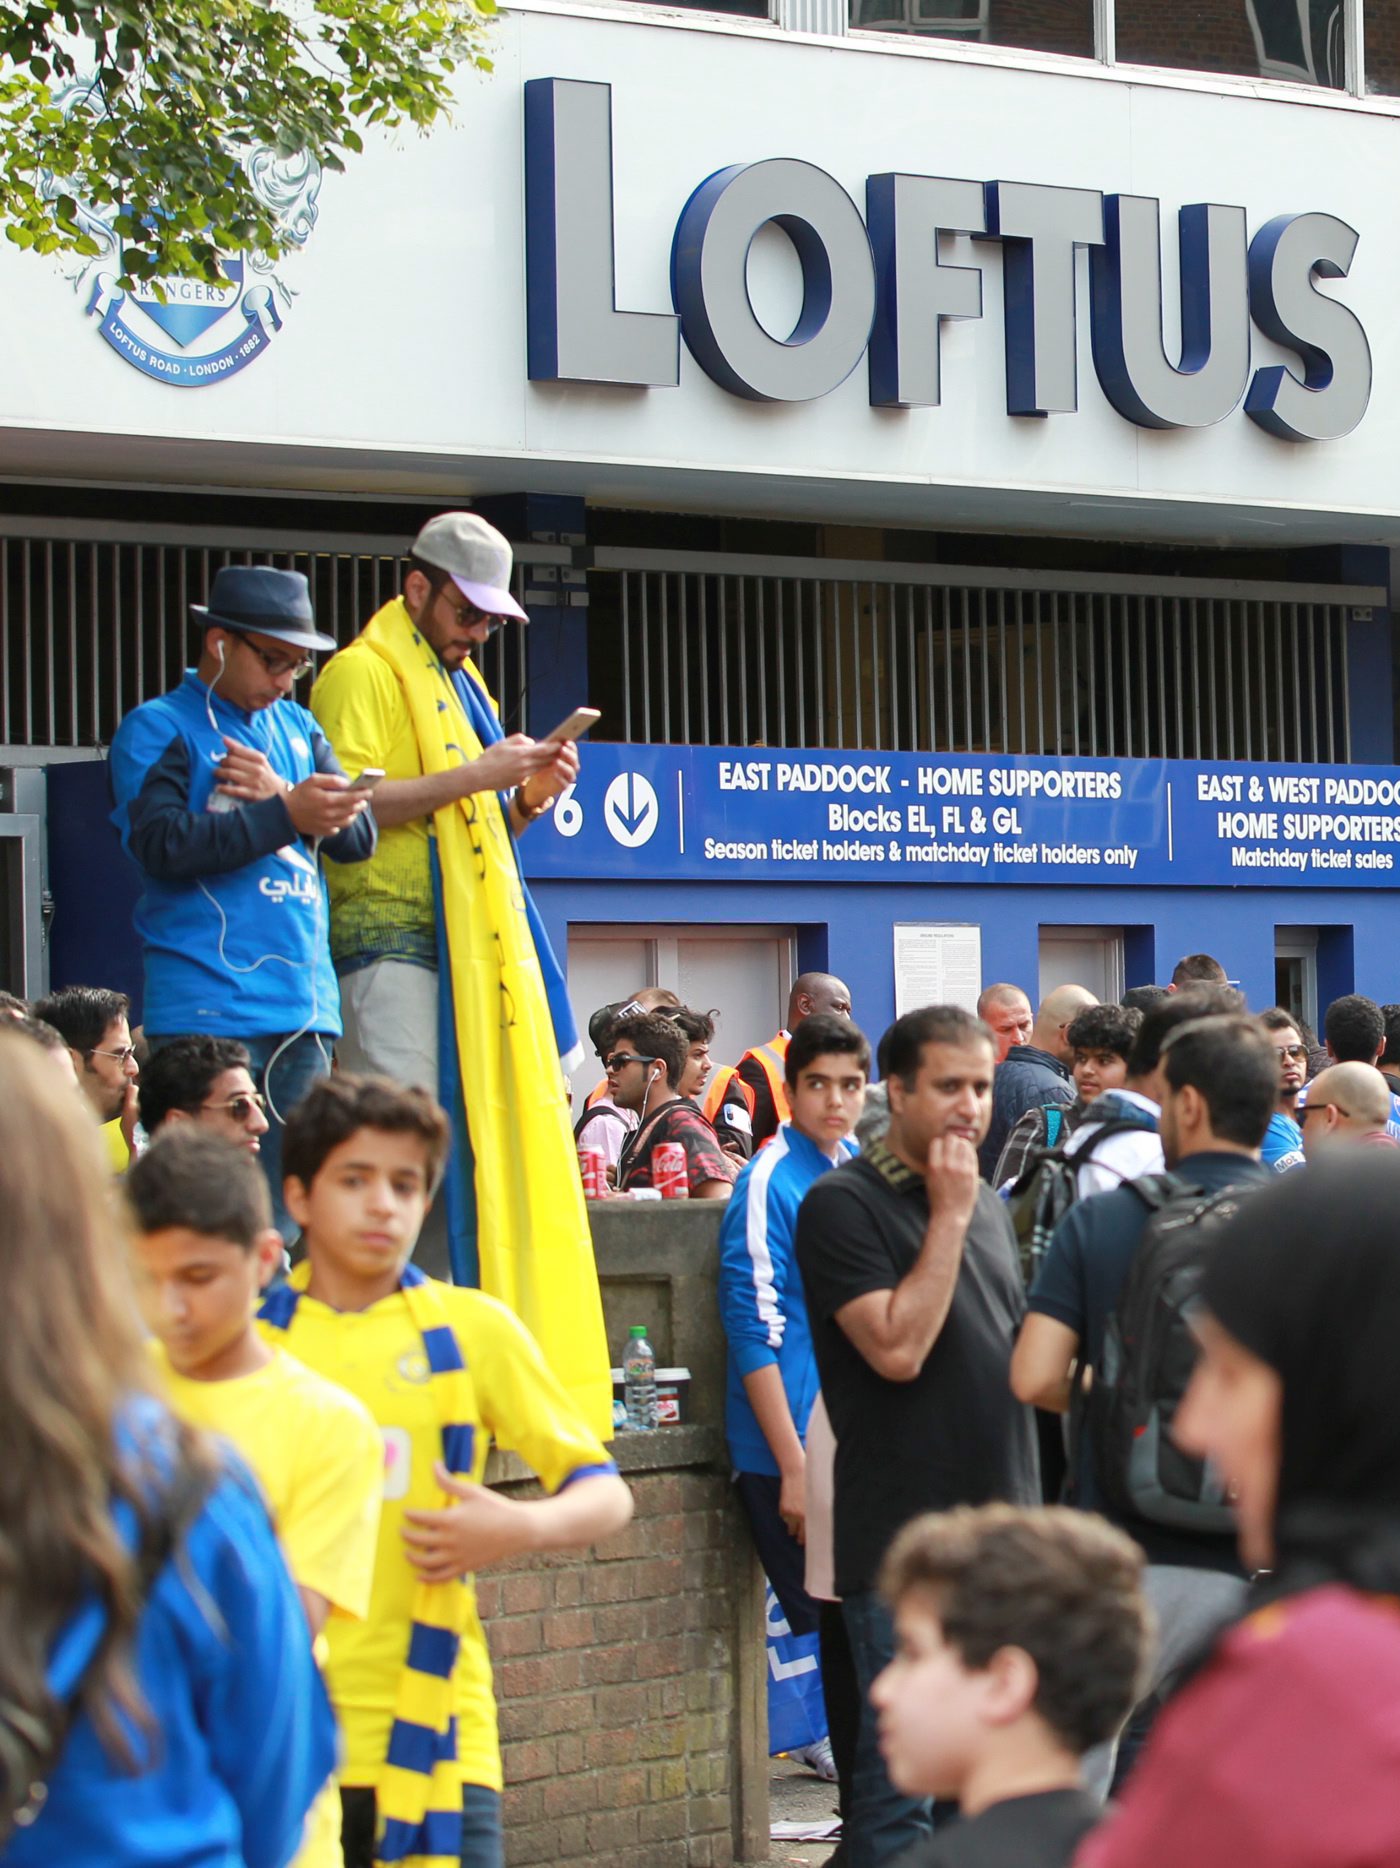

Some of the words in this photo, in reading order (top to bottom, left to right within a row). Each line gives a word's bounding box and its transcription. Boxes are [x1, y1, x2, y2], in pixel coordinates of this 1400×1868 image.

[140, 281, 227, 302] RNGERS
[109, 321, 147, 362] LOFTUS
[149, 355, 181, 375] ROAD
[189, 355, 234, 377] LONDON
[239, 333, 261, 358] 1882
[719, 762, 771, 790] EAST
[777, 764, 891, 794] PADDOCK
[917, 767, 984, 796] HOME
[989, 768, 1122, 799] SUPPORTERS
[1197, 774, 1244, 801] EAST
[1248, 776, 1264, 803] &
[1268, 776, 1320, 804] WEST
[828, 802, 902, 833] Blocks
[907, 805, 936, 839] EL,
[942, 806, 966, 834] FL
[970, 807, 987, 834] &
[992, 808, 1022, 835] GL
[1218, 812, 1278, 840] HOME
[704, 837, 769, 860] Season
[771, 838, 819, 861] ticket
[822, 840, 885, 862] holders
[889, 841, 902, 862] &
[906, 841, 990, 867] matchday
[993, 843, 1038, 864] ticket
[1041, 844, 1100, 865] holders
[1104, 845, 1138, 869] only
[1231, 846, 1308, 872] Matchday
[1311, 848, 1352, 869] ticket
[1354, 849, 1394, 870] sales
